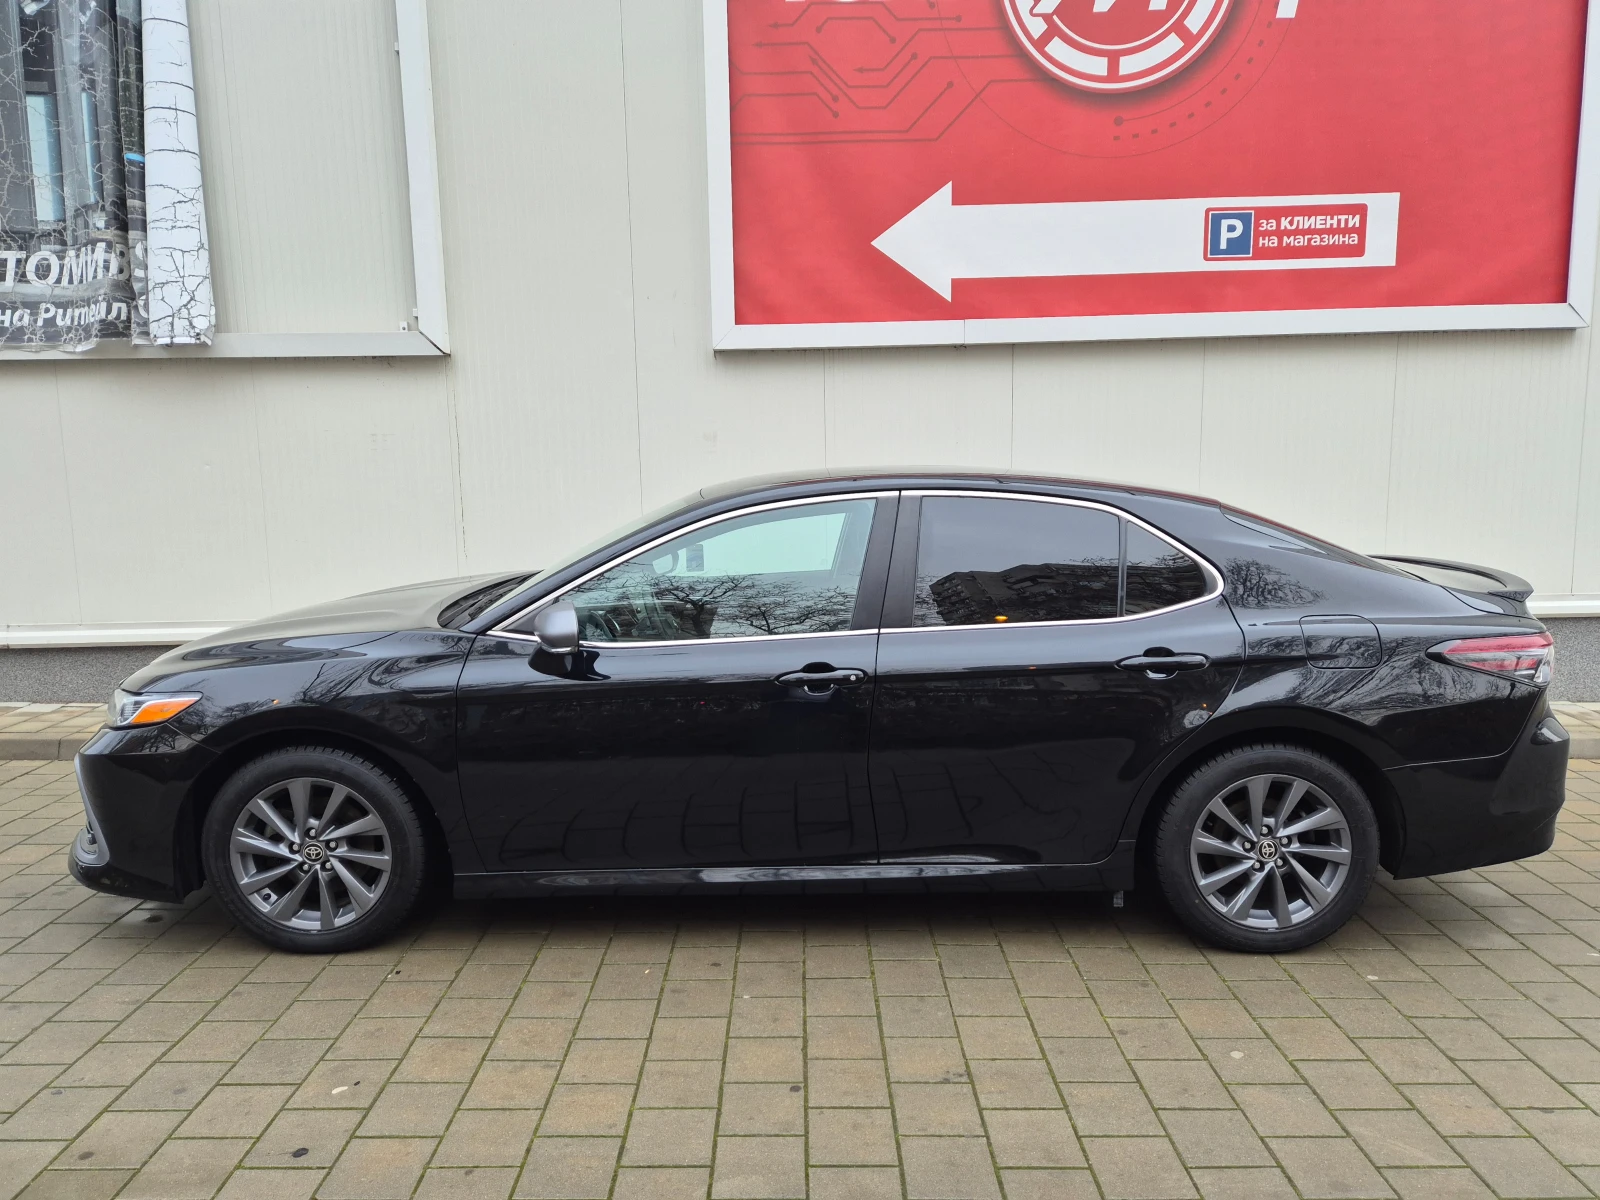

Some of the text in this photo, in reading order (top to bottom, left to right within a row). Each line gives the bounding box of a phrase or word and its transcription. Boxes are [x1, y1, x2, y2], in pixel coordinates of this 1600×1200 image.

[1258, 214, 1361, 231] за КЛИЕНТИ
[1219, 218, 1244, 250] P
[1258, 233, 1359, 248] на магазина
